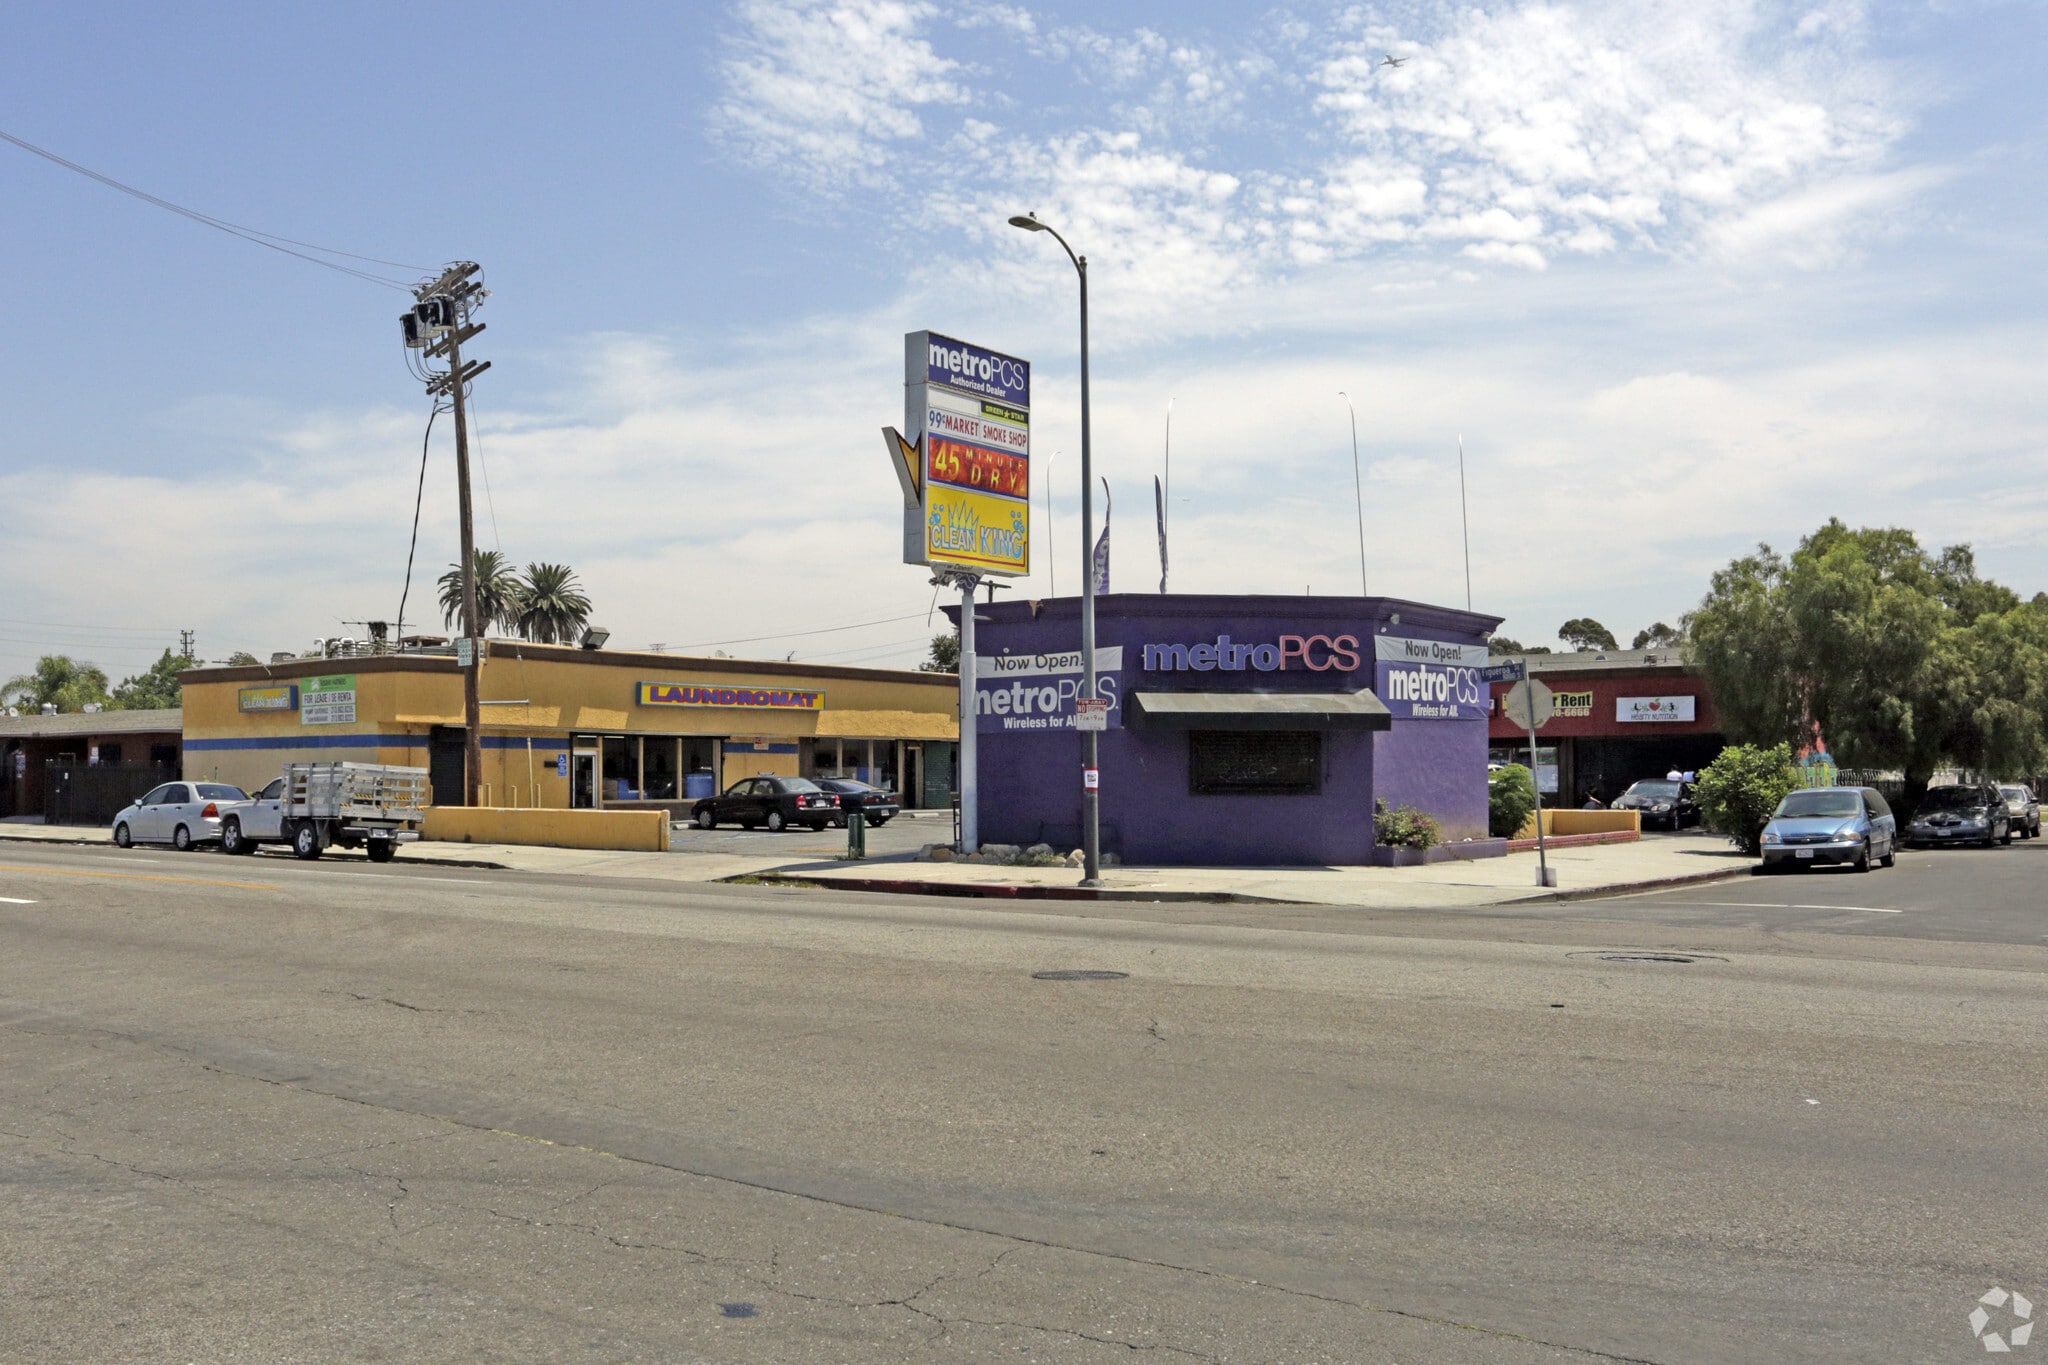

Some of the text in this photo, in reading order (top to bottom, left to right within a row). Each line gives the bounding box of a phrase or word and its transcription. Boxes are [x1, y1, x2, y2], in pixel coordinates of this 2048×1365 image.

[929, 343, 1024, 390] metroPCS
[950, 374, 1006, 397] Authorized Dealer
[1010, 411, 1025, 421] STAR
[983, 425, 1006, 443] SMOKE
[1009, 432, 1027, 447] SHOP
[935, 441, 960, 481] 45
[931, 524, 1023, 560] CLEAN KING
[1144, 635, 1361, 671] metroPCS
[1405, 640, 1462, 661] Now Open!
[994, 656, 1030, 671] Now
[1481, 666, 1510, 678] Figueroa
[303, 694, 313, 704] FOR
[314, 693, 328, 703] LEASE
[650, 686, 817, 707] LAUNDROMAT
[1561, 694, 1591, 707] Rent
[1077, 705, 1086, 713] NO
[1412, 703, 1438, 716] Wireless
[1004, 716, 1047, 729] Wireless
[1049, 716, 1063, 727] for
